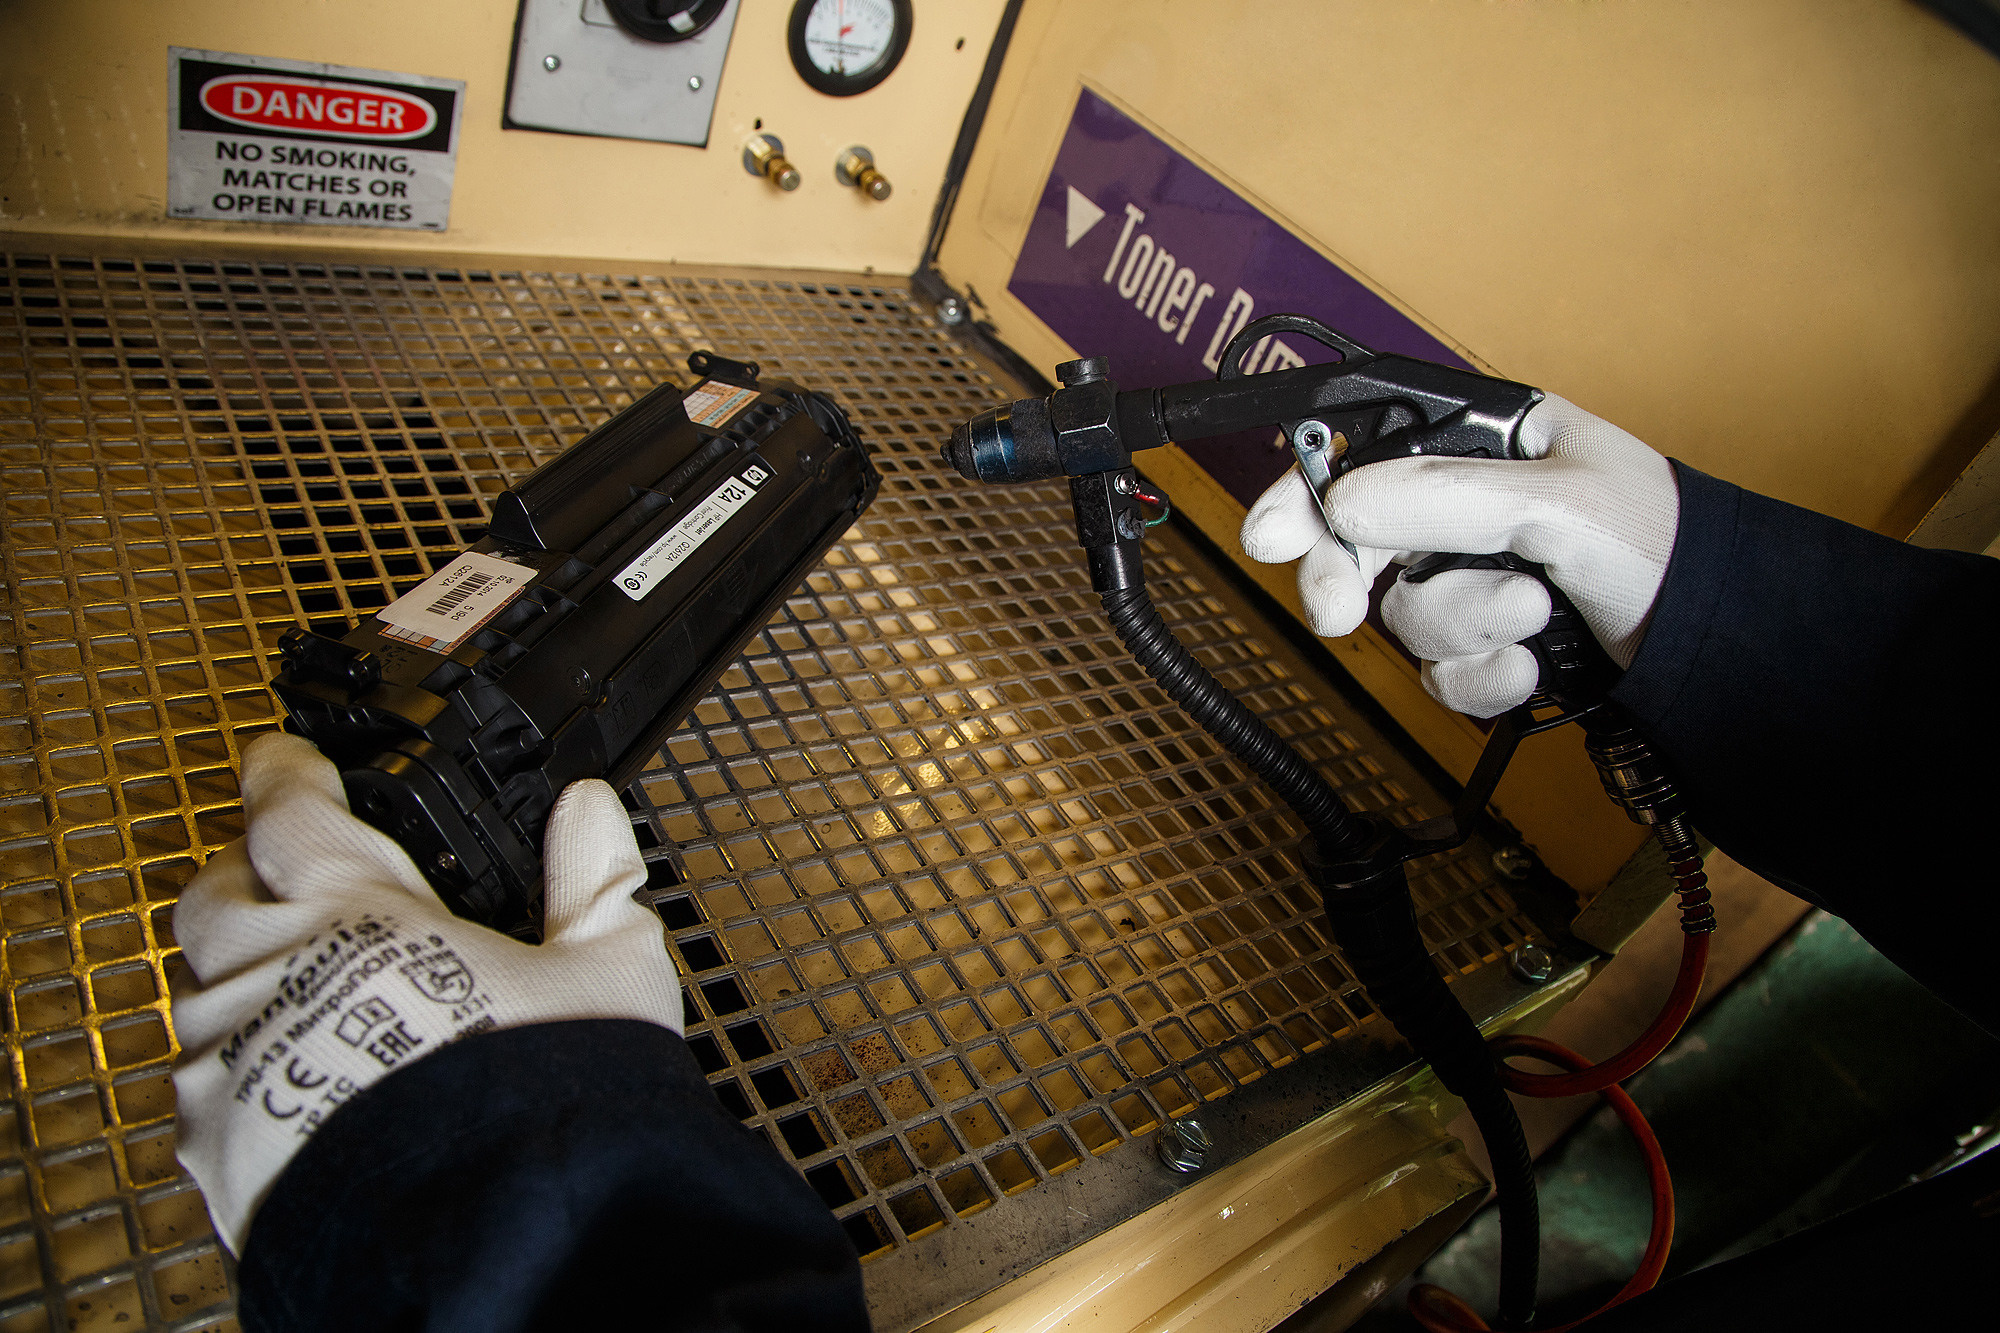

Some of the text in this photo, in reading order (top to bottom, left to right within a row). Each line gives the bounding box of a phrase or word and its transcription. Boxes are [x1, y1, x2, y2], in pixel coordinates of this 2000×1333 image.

[232, 85, 405, 129] DANGER
[215, 140, 416, 177] NO SMOKING,
[222, 168, 408, 198] MATCHES OR
[212, 192, 294, 216] OPEN
[302, 198, 412, 222] FLAMES
[1103, 202, 1215, 345] Toner
[717, 484, 747, 504] 12A
[682, 513, 705, 530] Cartridge
[695, 517, 717, 536] LaserJet
[665, 541, 690, 562] Q2612A
